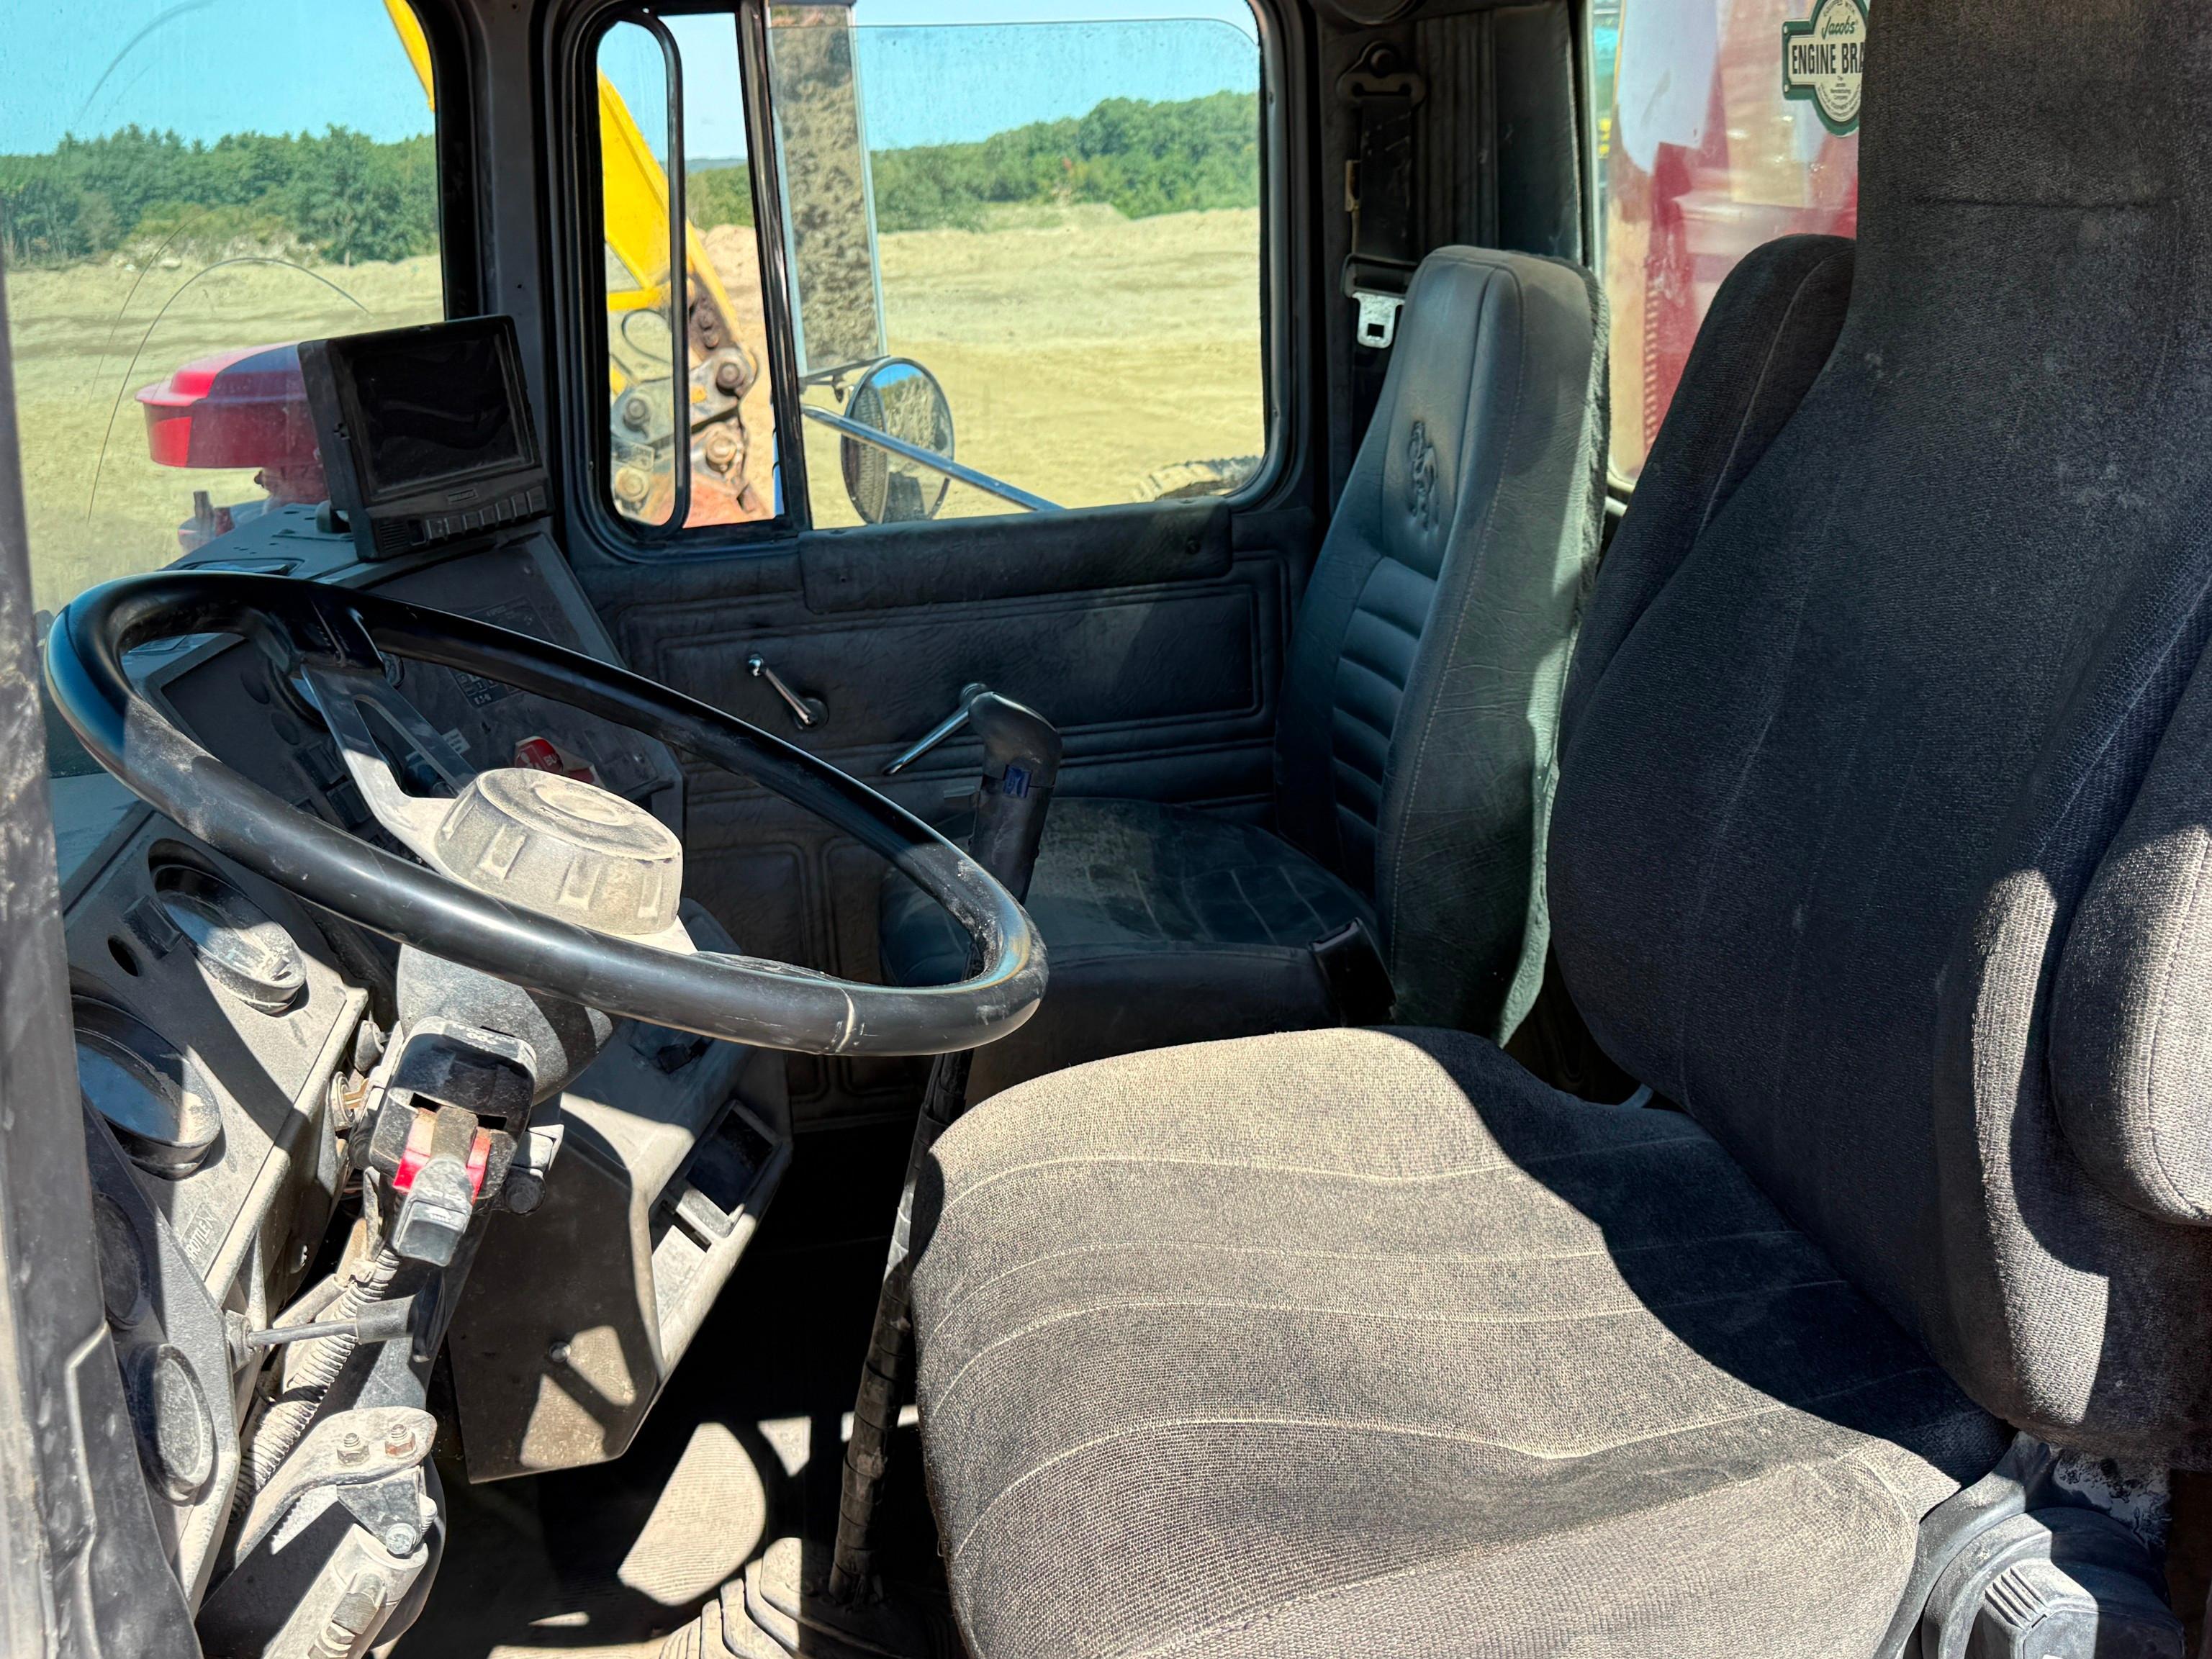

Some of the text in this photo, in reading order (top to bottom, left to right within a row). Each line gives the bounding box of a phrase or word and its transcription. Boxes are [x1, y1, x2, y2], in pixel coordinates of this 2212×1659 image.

[1821, 15, 1856, 40] Jacobs
[1792, 42, 1865, 75] ENGINE BRA
[185, 1220, 211, 1265] HROTTLE
